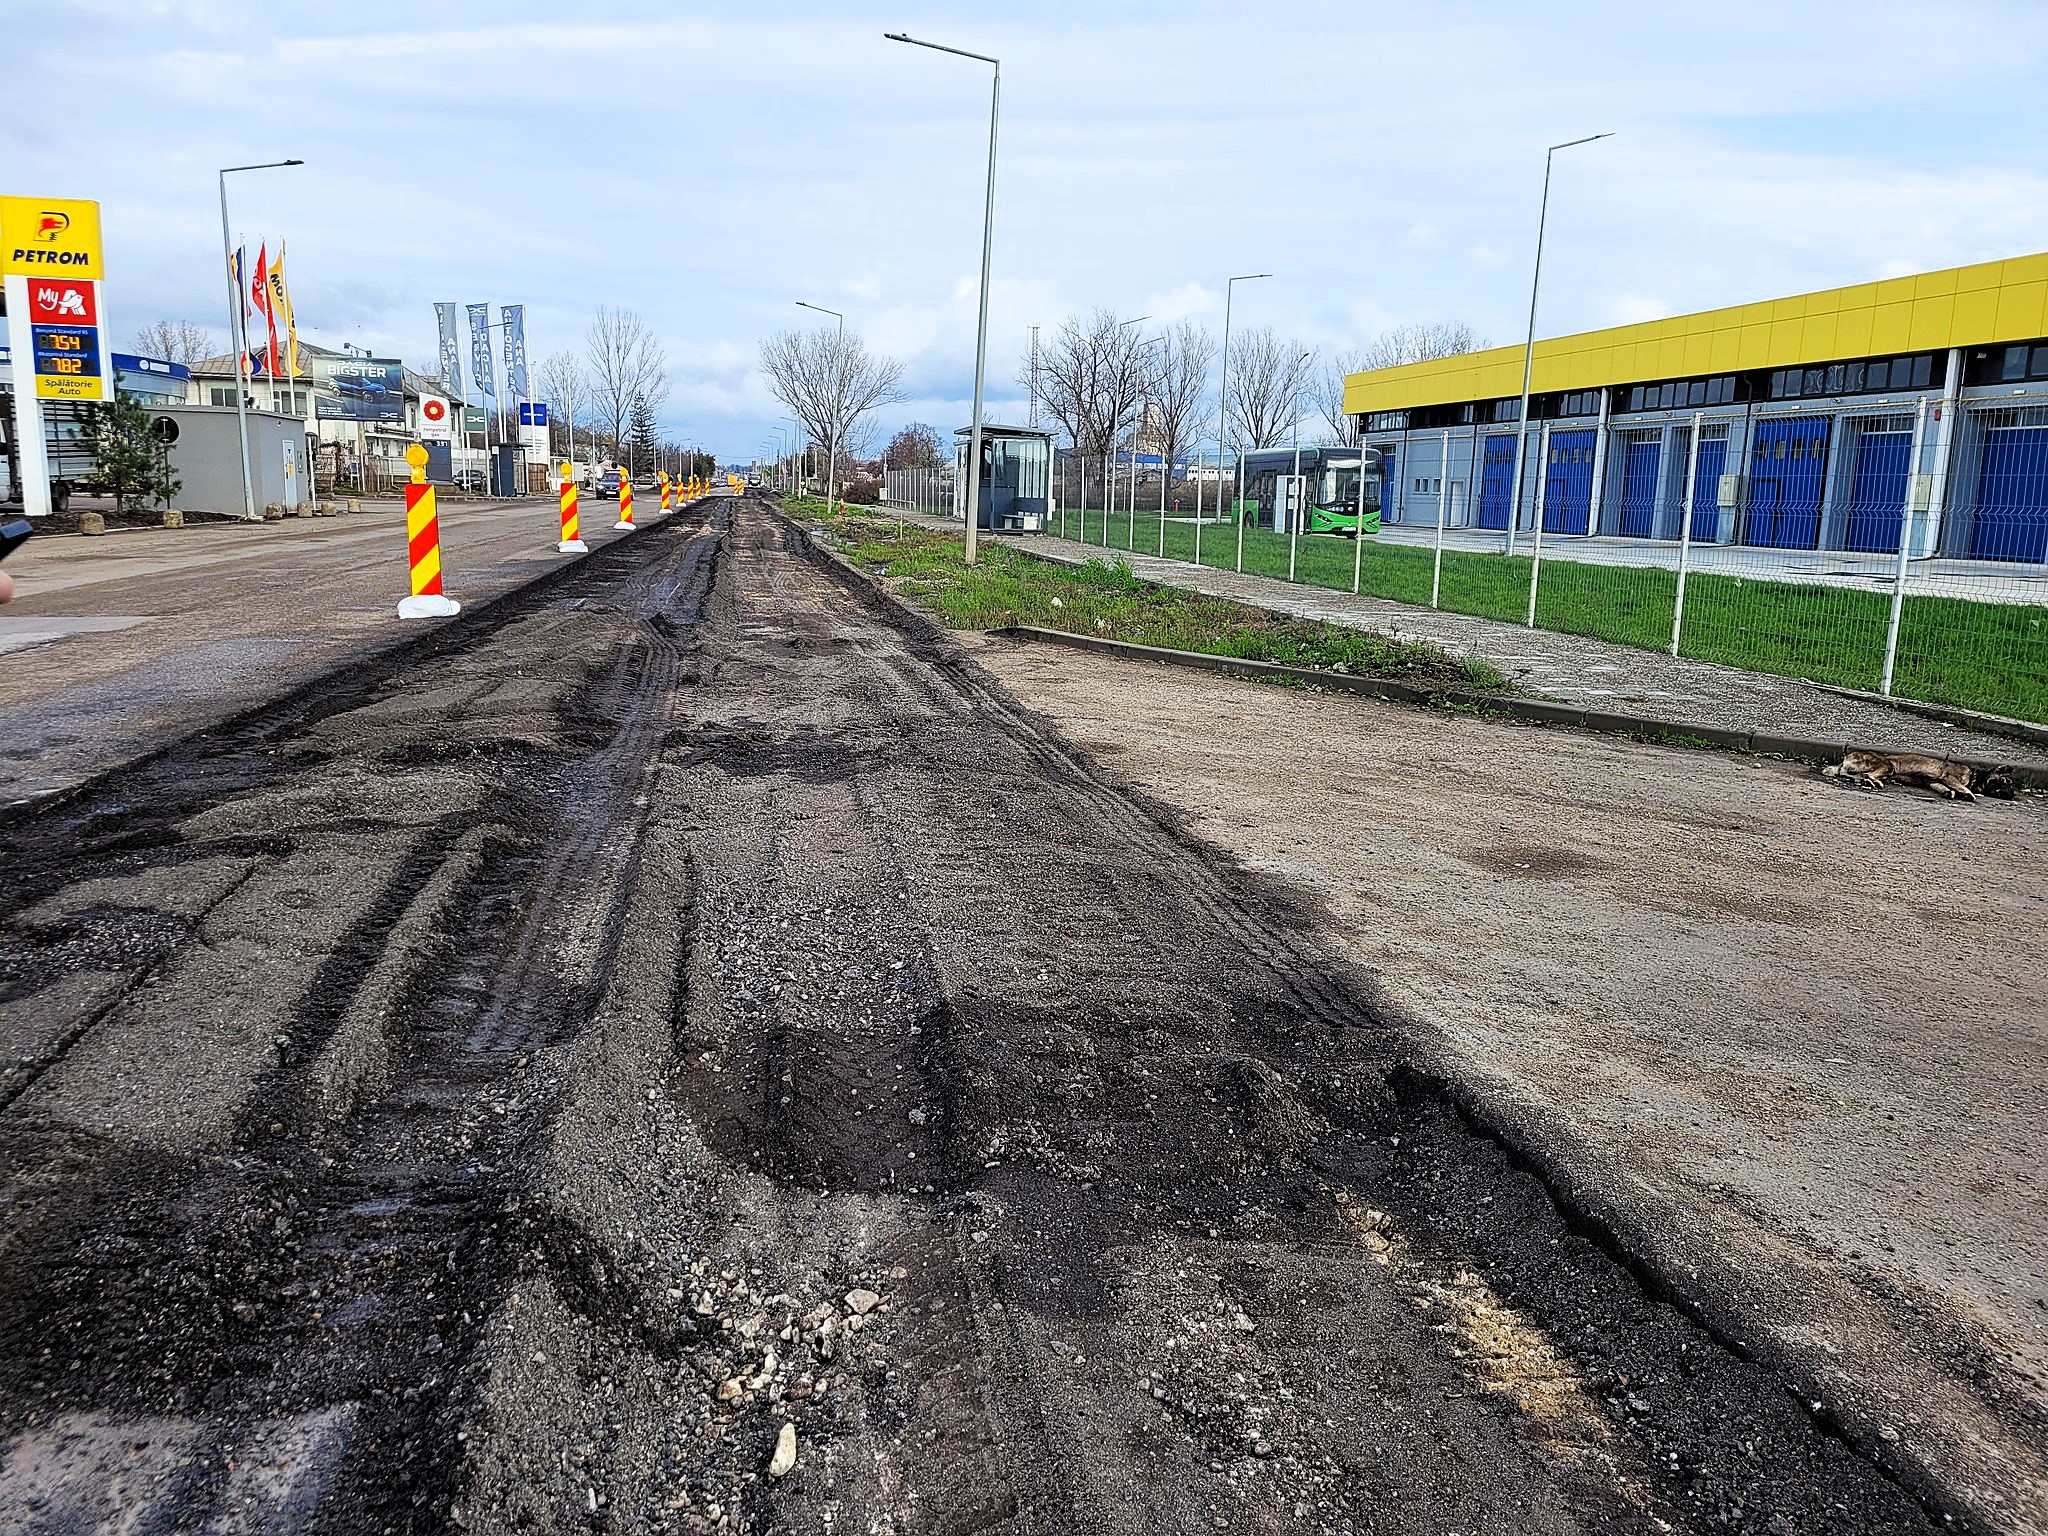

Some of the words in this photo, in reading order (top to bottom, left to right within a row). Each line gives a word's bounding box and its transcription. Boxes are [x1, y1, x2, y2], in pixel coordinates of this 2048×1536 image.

[13, 249, 89, 265] PETROM
[38, 287, 59, 311] My
[327, 364, 387, 378] BIGSTER
[58, 387, 81, 395] Auto
